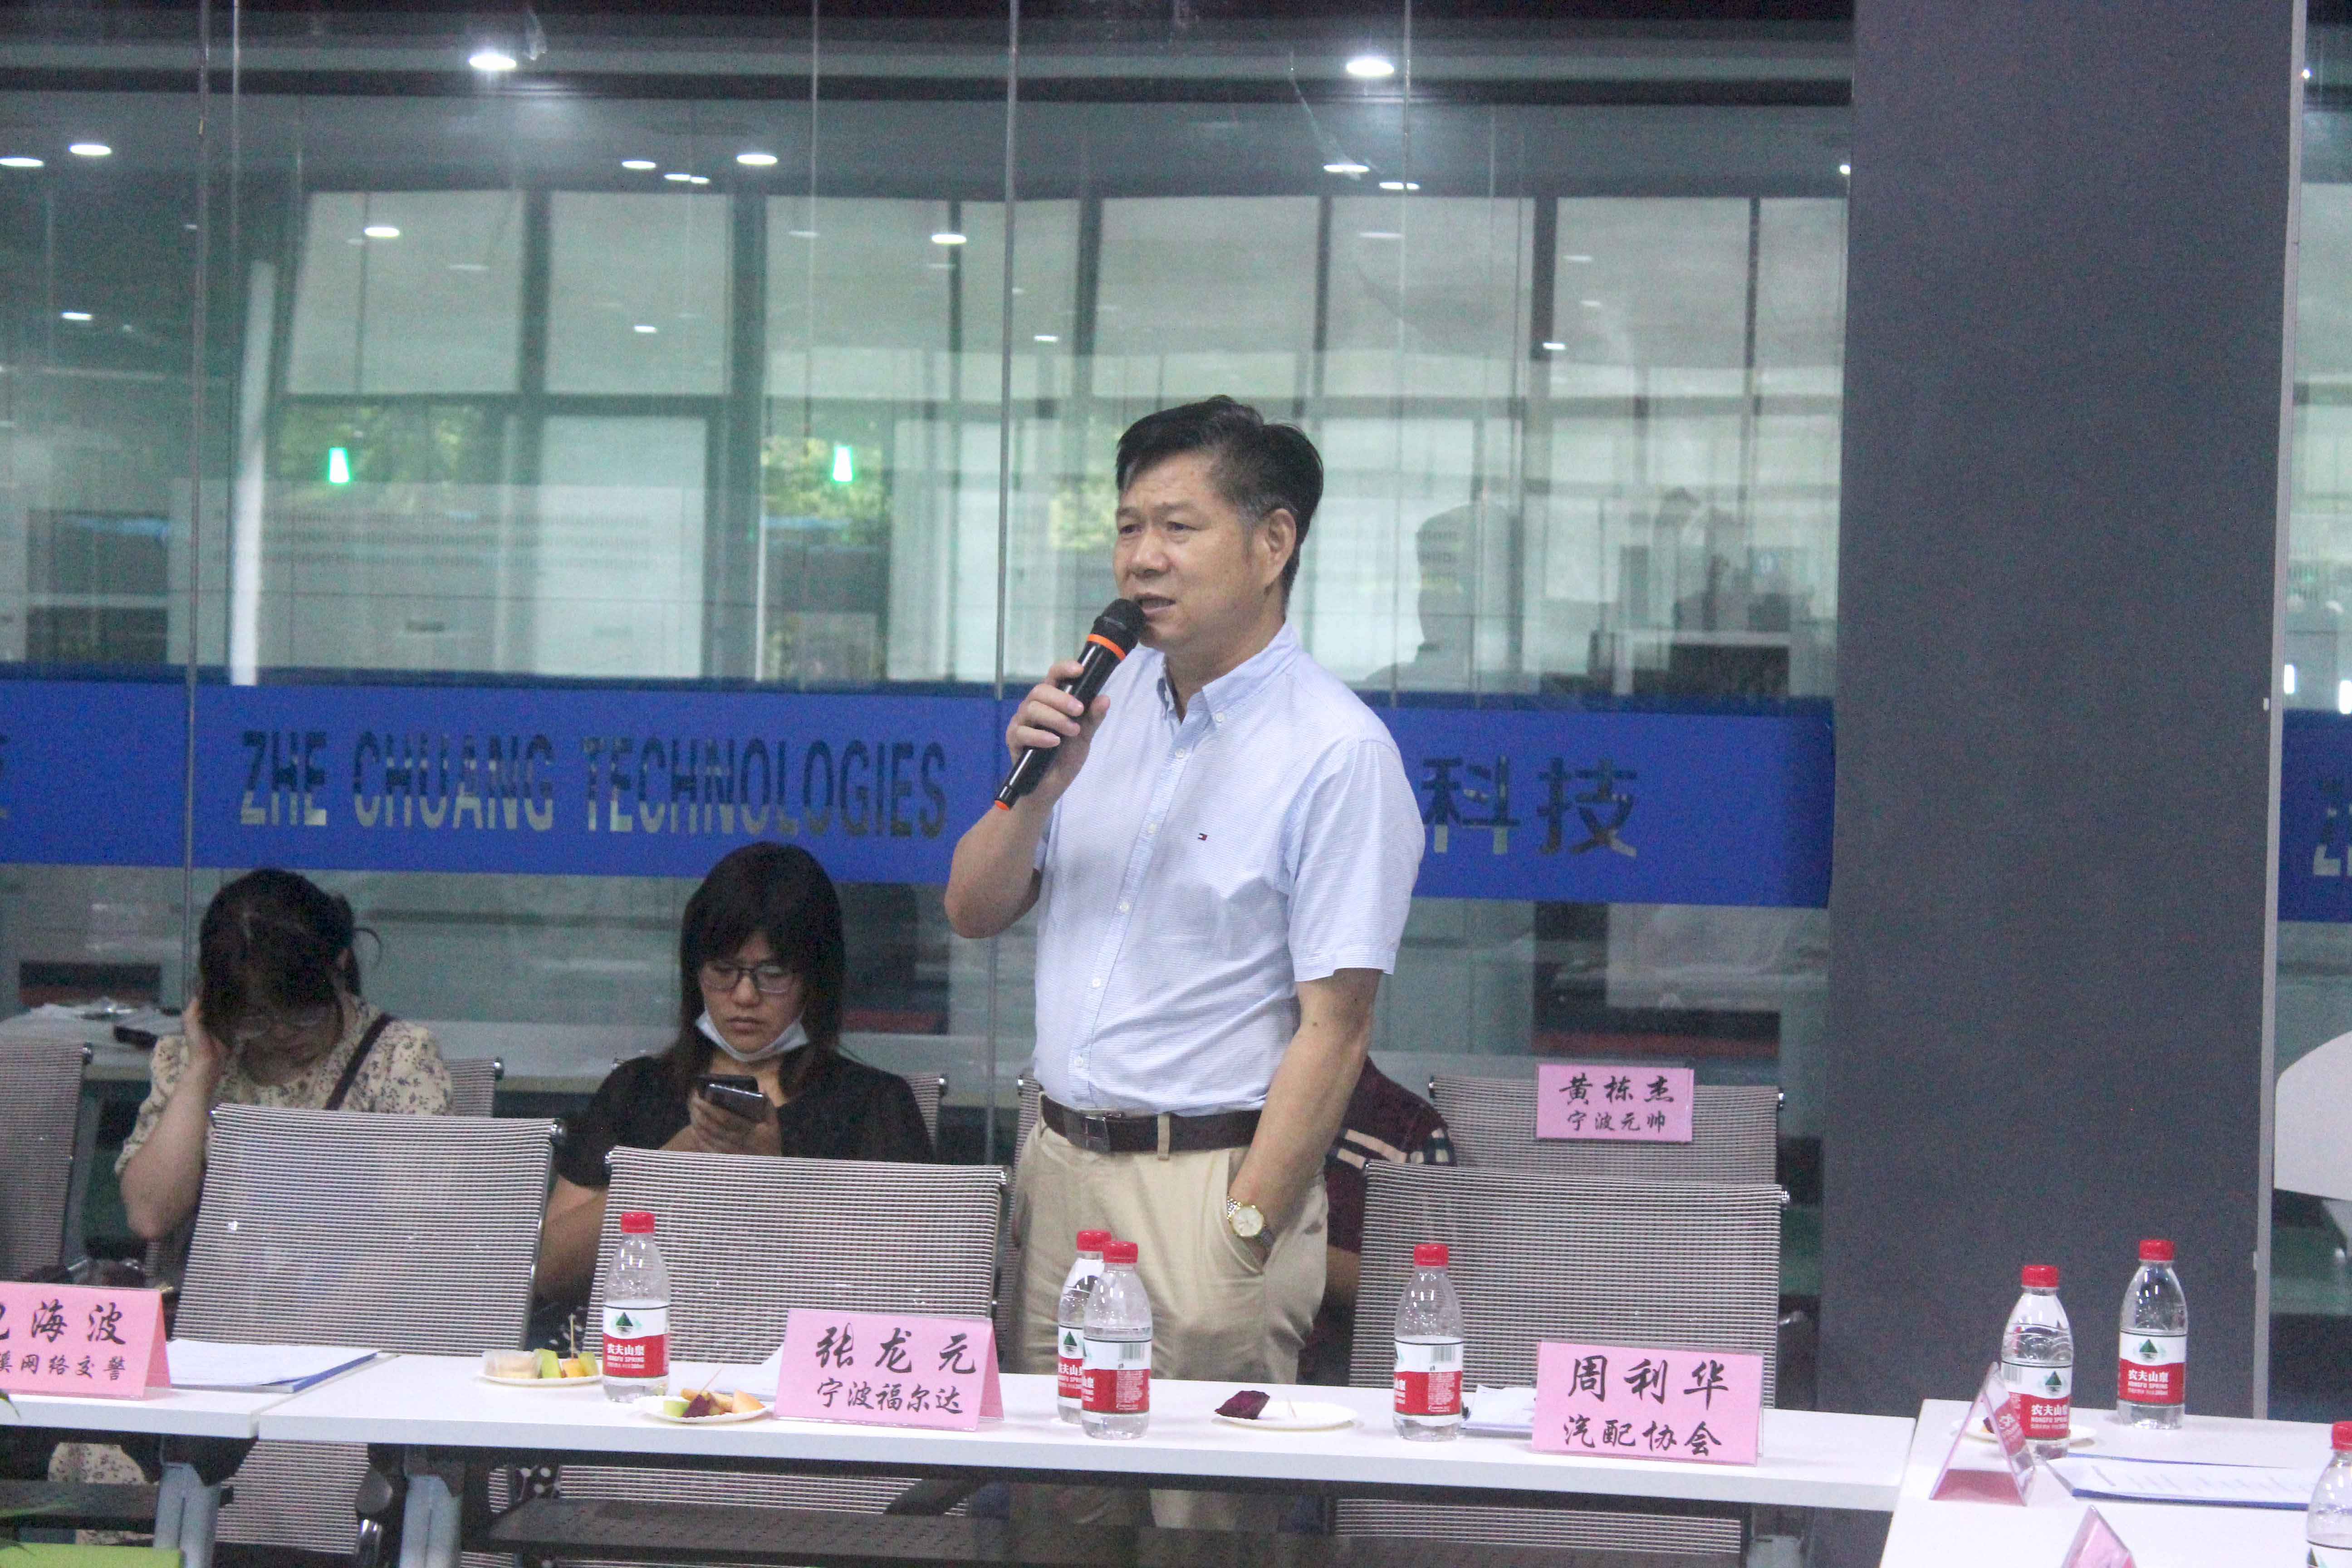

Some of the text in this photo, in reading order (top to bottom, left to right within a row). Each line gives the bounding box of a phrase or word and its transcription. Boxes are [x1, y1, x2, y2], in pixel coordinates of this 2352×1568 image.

[241, 731, 946, 838] ZHE CHUANG TECHNOLOGIES
[1421, 755, 1637, 857] 科技
[1559, 1073, 1674, 1106] 黄栋杰
[1568, 1111, 1666, 1133] 宁波元帅
[816, 1323, 976, 1374] 张龙元
[817, 1377, 963, 1414] 宁波福尔达
[1568, 1355, 1729, 1410] 周利华
[1563, 1414, 1722, 1456] 汽配协会
